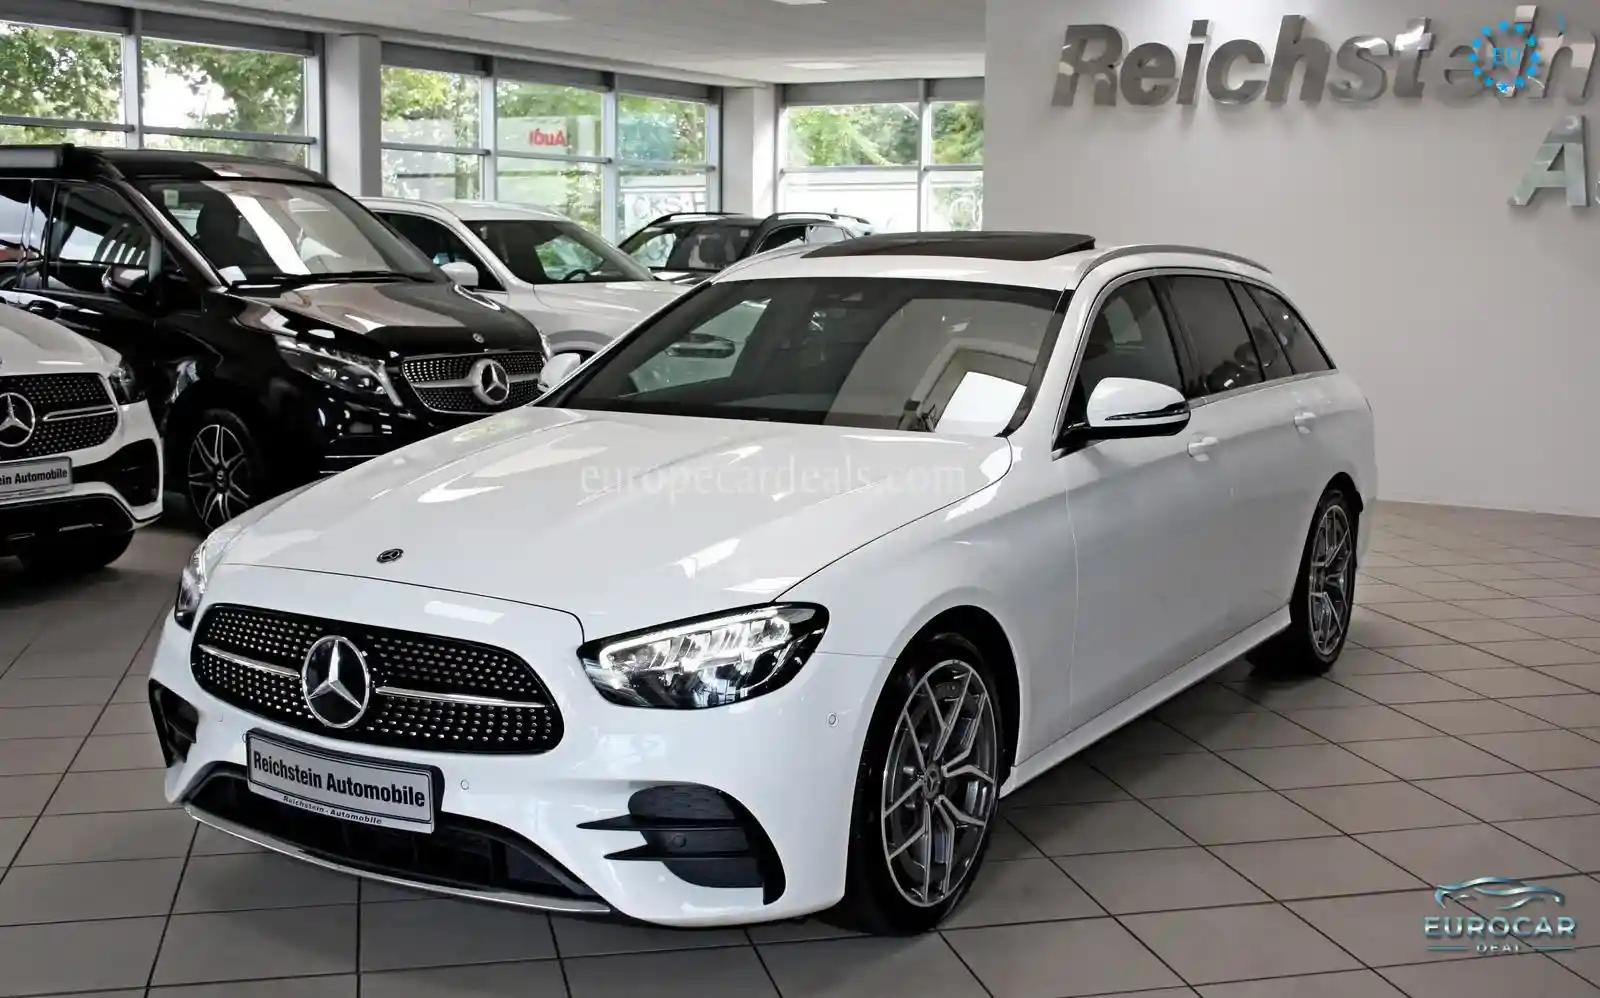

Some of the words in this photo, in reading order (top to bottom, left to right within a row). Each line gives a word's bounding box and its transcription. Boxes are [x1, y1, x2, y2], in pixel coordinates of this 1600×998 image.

[1050, 5, 1597, 107] Reichstein
[1508, 114, 1600, 208] A
[15, 468, 68, 485] Automobile
[253, 750, 323, 789] Reichstein
[326, 772, 425, 807] Automobile
[283, 794, 325, 813] Reichstein
[330, 808, 383, 825] Automobile
